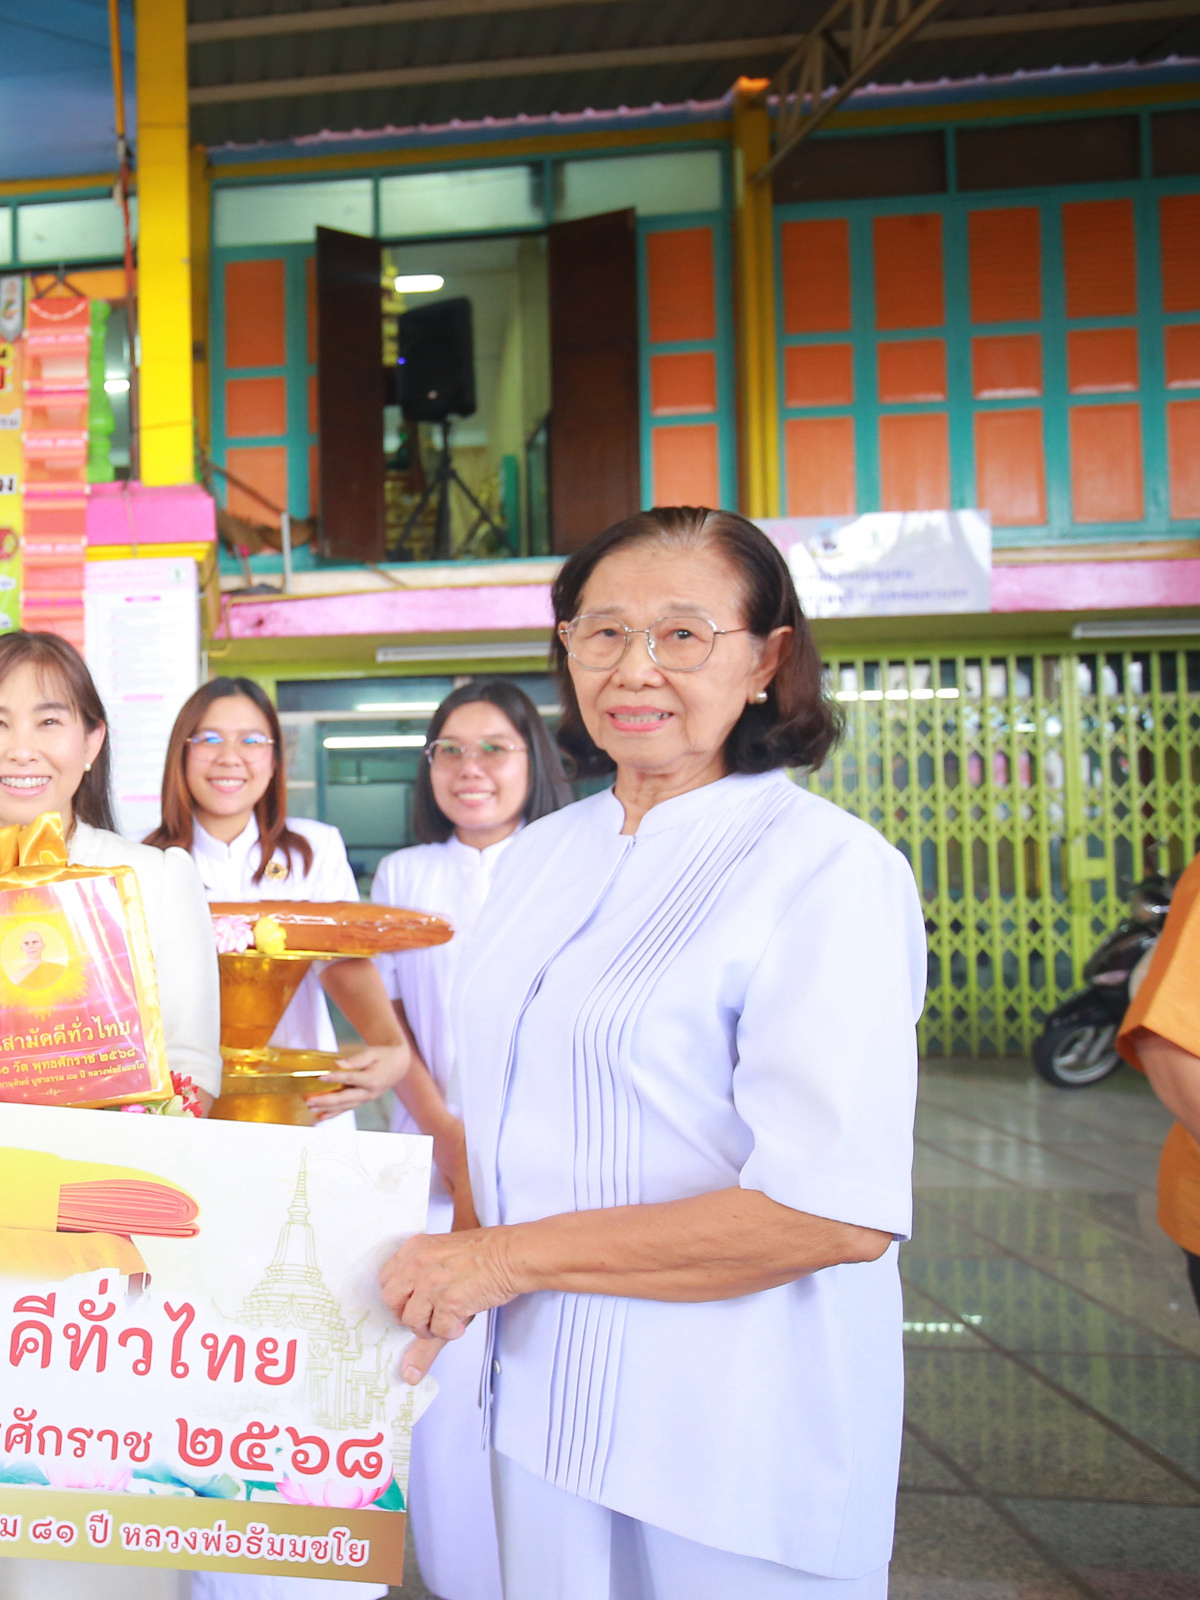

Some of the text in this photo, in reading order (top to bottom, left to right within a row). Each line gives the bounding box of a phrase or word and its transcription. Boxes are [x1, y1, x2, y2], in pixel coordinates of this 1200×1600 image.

[13, 1060, 29, 1073] วัด
[32, 1053, 96, 1075] พุทธศักราช
[176, 1417, 385, 1480] ๒๕๖๘
[32, 1519, 75, 1544] ๘๑
[89, 1513, 109, 1545] ปี
[122, 1523, 369, 1564] หลวงพ่อธัมมชโย
